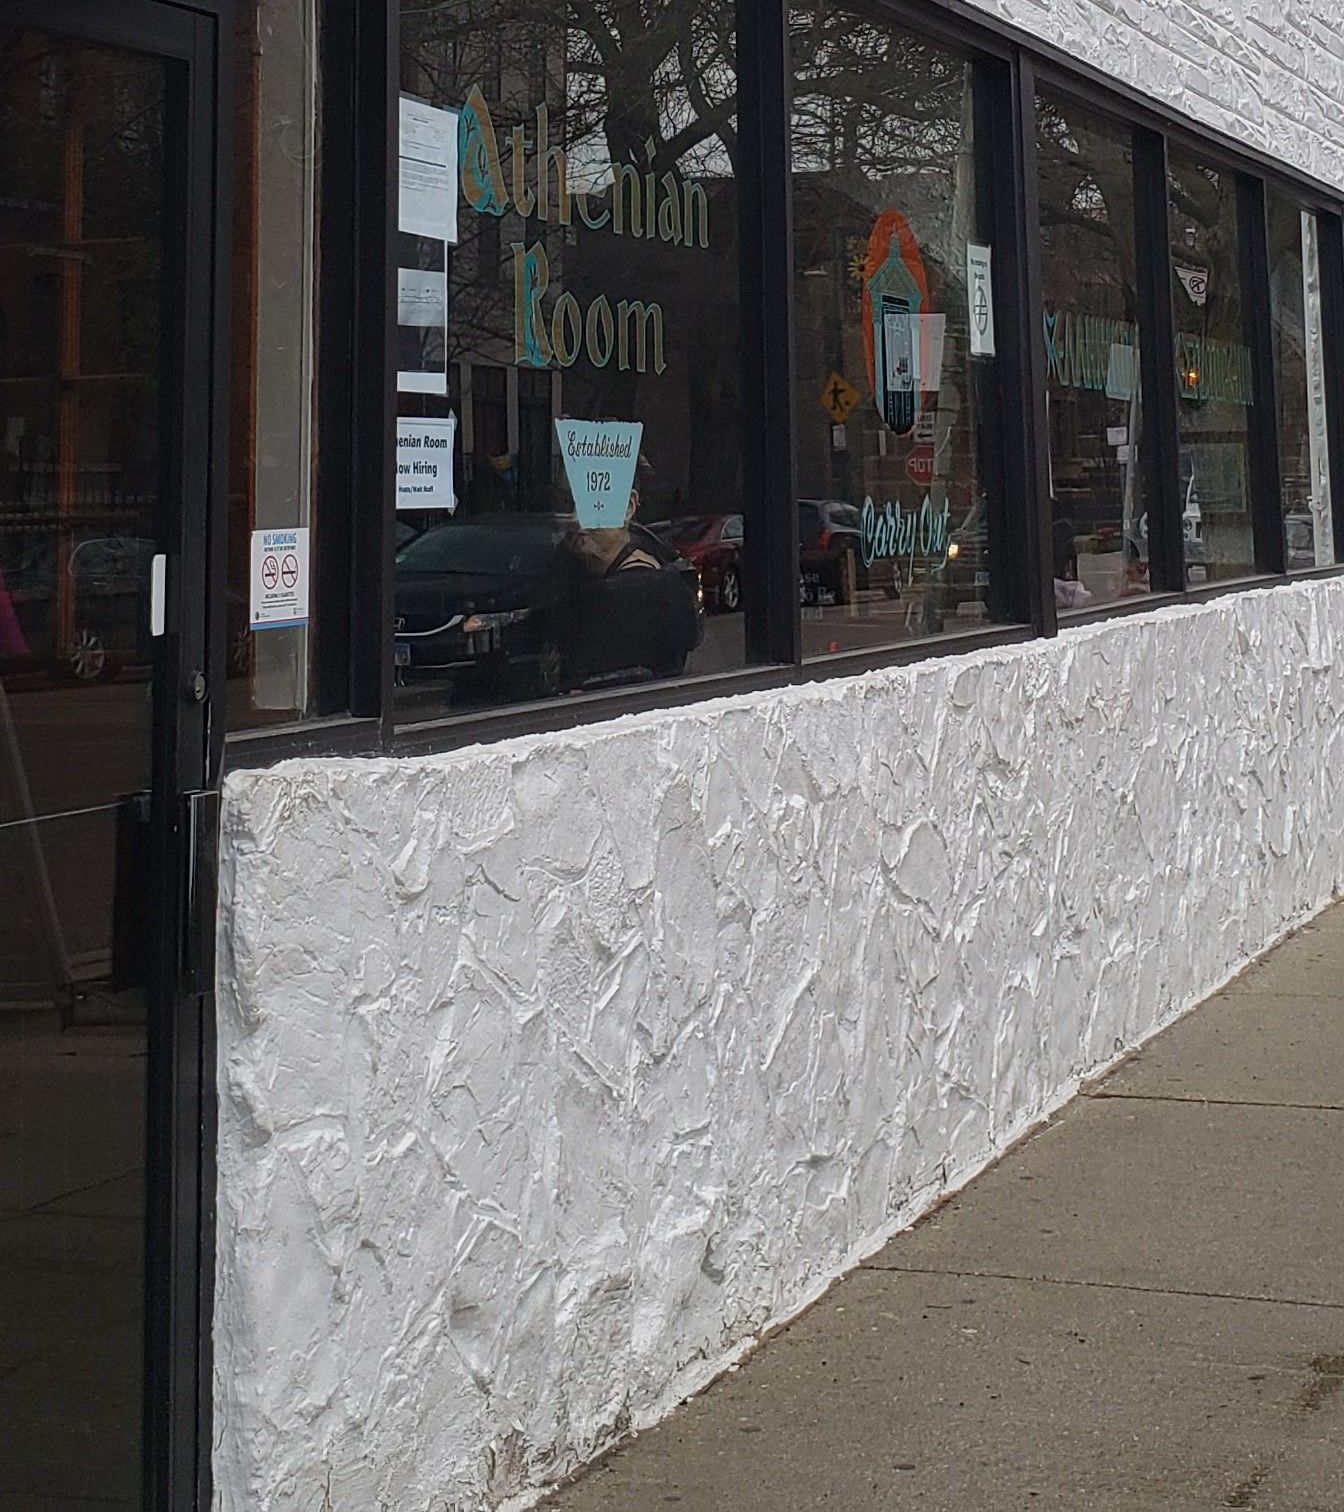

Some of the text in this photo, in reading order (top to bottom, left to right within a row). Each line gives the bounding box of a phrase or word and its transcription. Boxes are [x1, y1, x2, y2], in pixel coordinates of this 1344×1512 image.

[460, 84, 709, 249] Athenian
[510, 241, 667, 376] Room
[397, 433, 448, 449] enian Room
[567, 430, 632, 462] Established
[397, 460, 438, 478] ow Hiring
[586, 471, 611, 493] 1972
[272, 531, 297, 546] SMOKING
[861, 493, 951, 587] Carry Out
